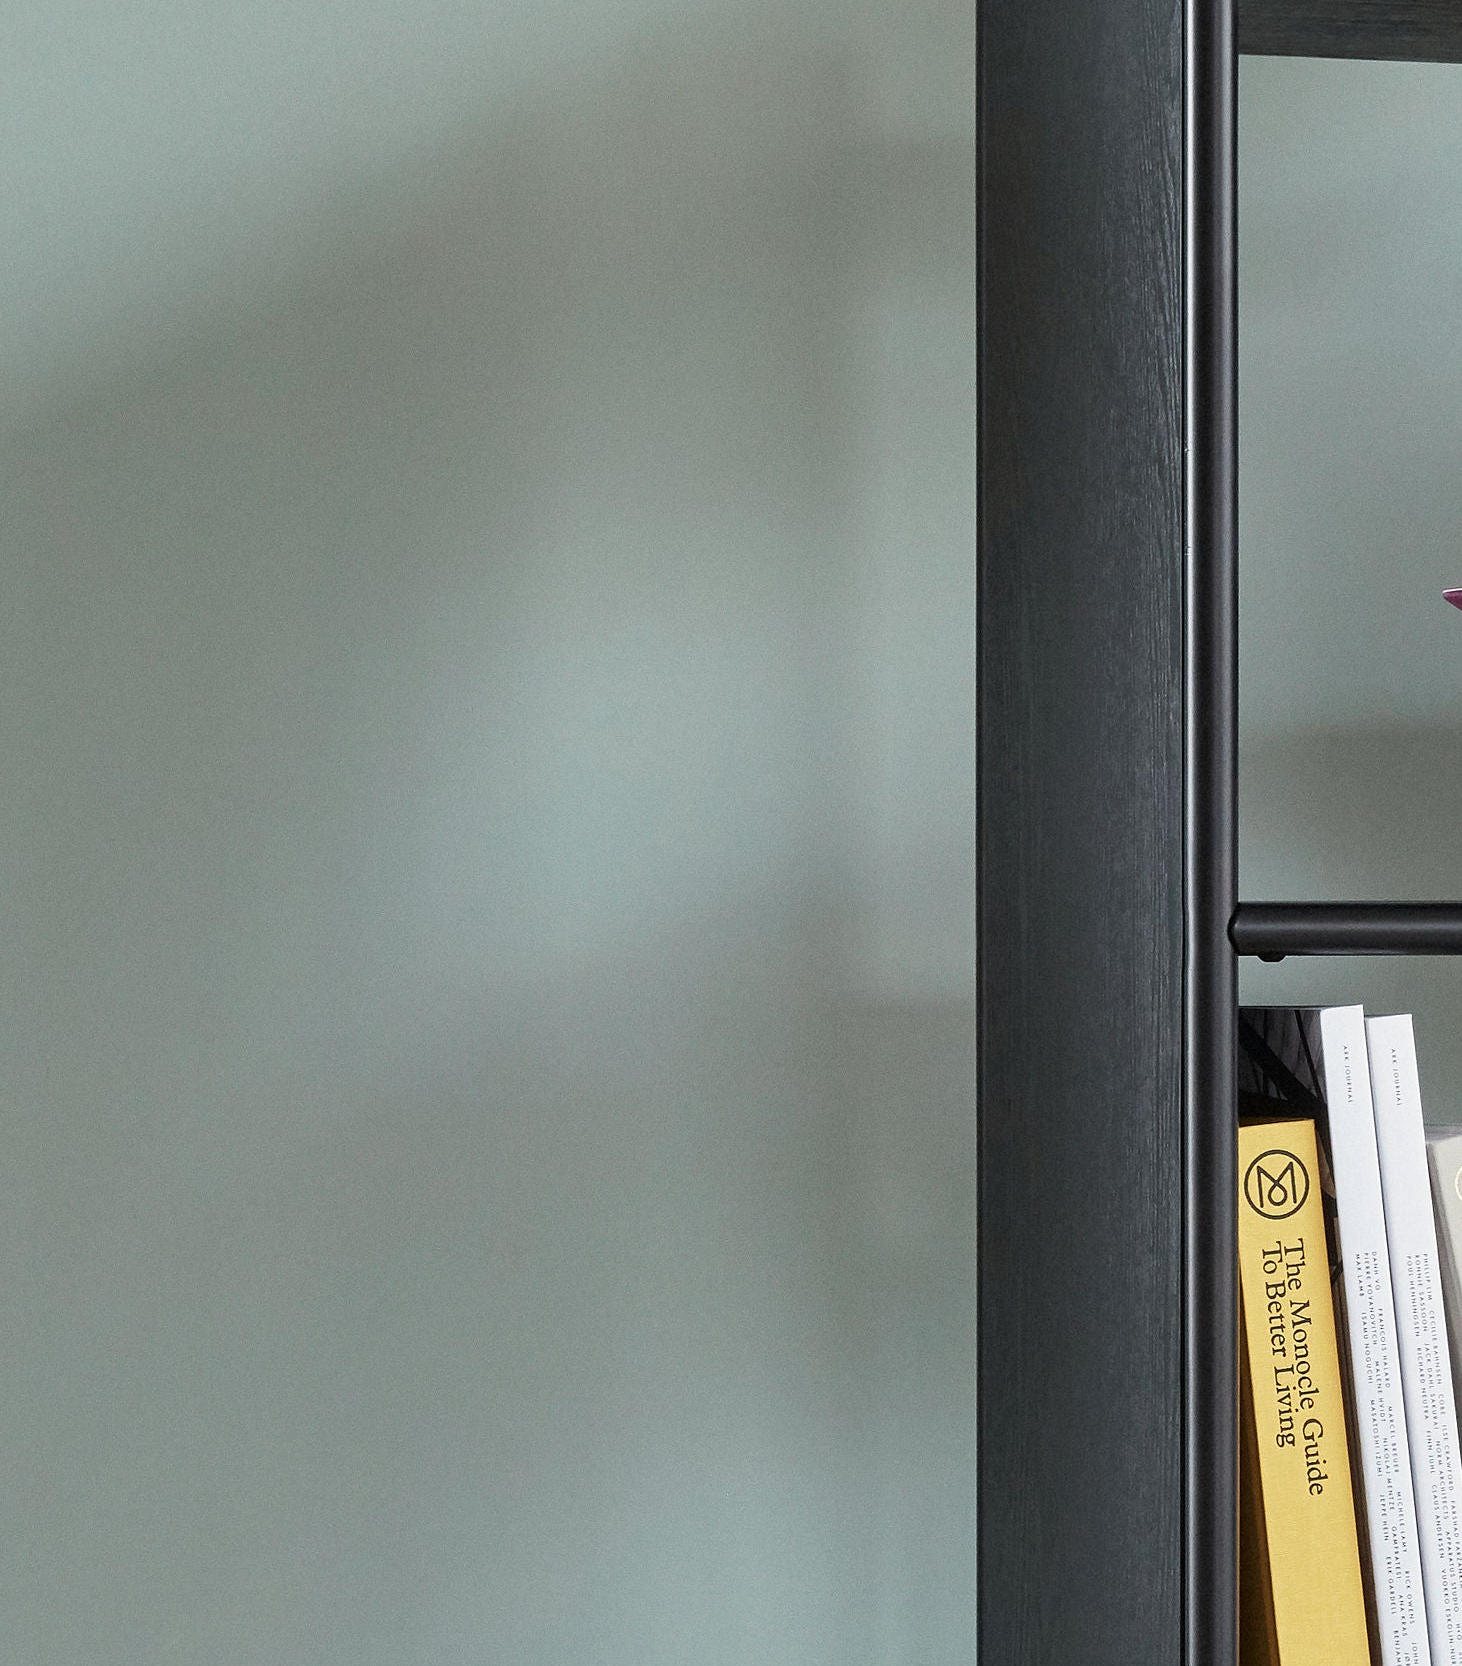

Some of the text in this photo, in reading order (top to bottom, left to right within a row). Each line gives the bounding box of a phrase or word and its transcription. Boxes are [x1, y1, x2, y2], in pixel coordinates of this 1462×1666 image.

[1345, 1065, 1353, 1103] JOURNAL
[1393, 1068, 1402, 1106] JOURNAL
[1261, 1241, 1299, 1448] To Better Living
[1283, 1238, 1328, 1496] The Monocle Guide
